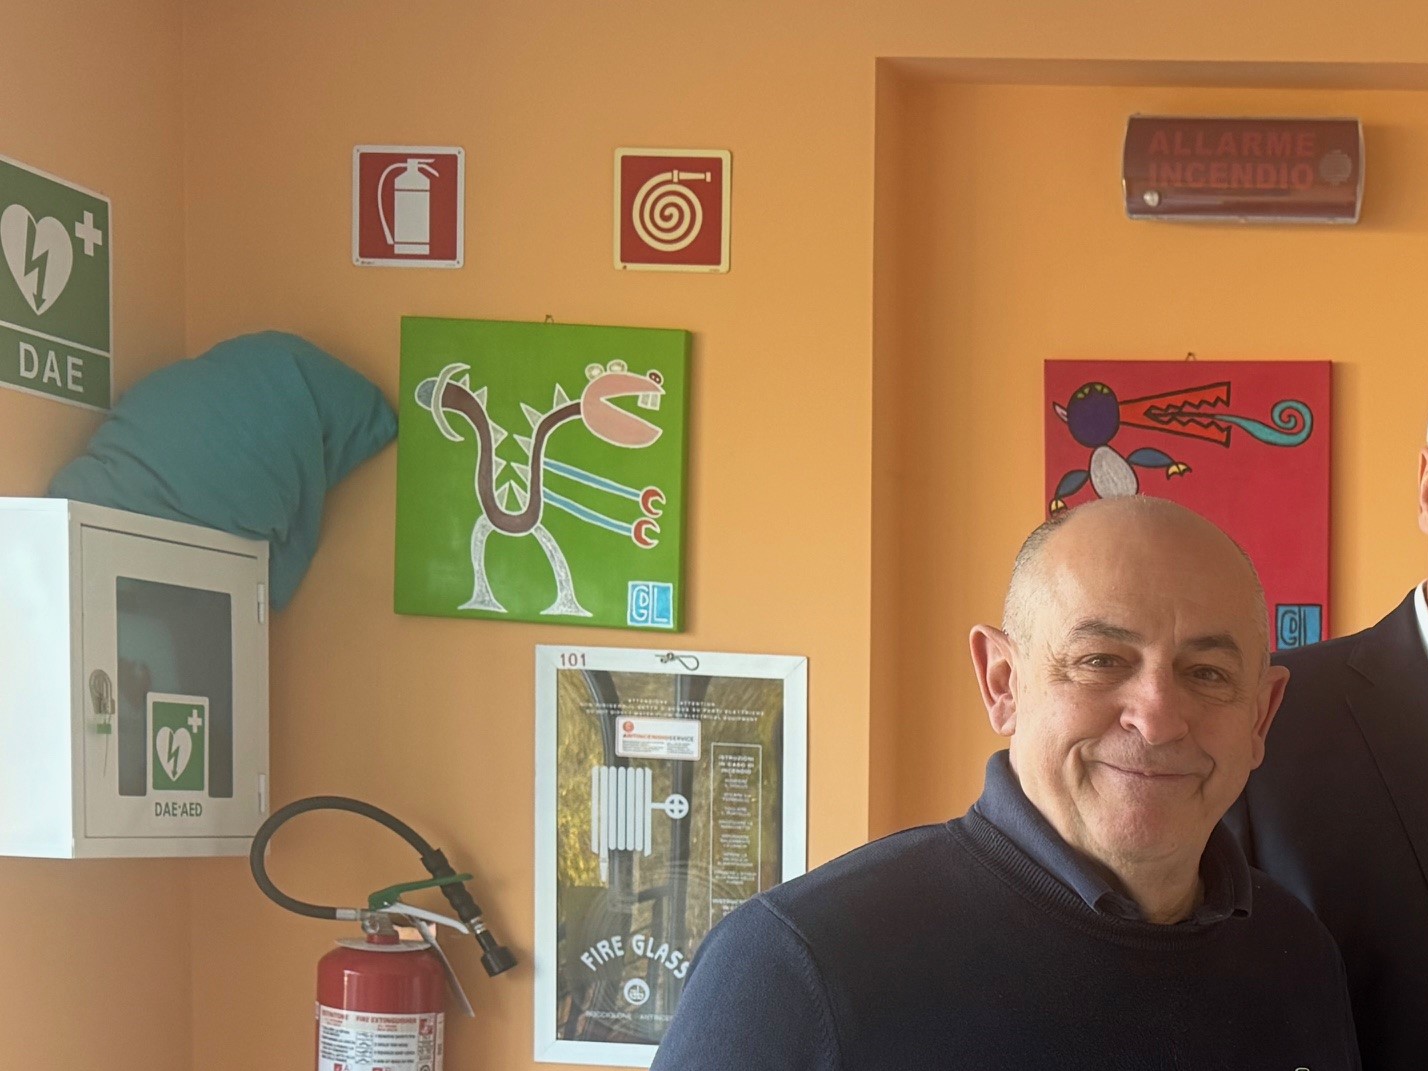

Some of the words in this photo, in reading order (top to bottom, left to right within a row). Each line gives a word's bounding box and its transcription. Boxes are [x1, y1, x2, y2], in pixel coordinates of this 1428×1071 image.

[1147, 129, 1316, 158] ALLARME
[1149, 161, 1316, 190] INCENDIO
[18, 341, 85, 394] DAE
[559, 653, 587, 668] 101
[580, 935, 625, 972] FIRE
[631, 934, 690, 979] GLASS
